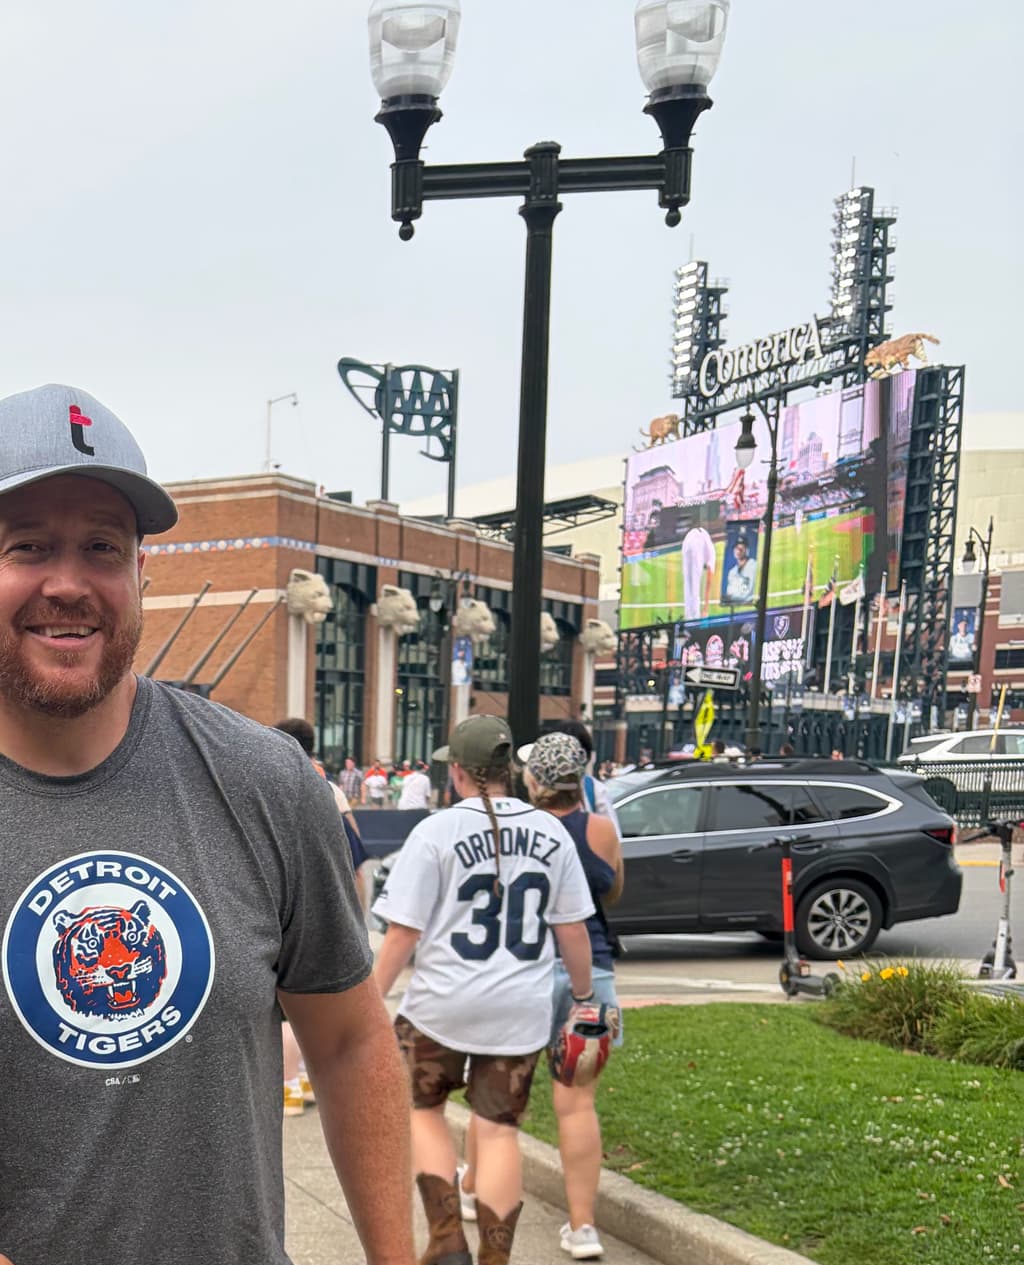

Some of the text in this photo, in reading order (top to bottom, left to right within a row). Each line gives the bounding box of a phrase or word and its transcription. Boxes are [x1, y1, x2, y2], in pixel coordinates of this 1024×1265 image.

[454, 827, 561, 869] ORDONEZ
[27, 861, 178, 917] DETROIT
[451, 871, 551, 960] 30
[58, 1005, 182, 1055] TIGERS
